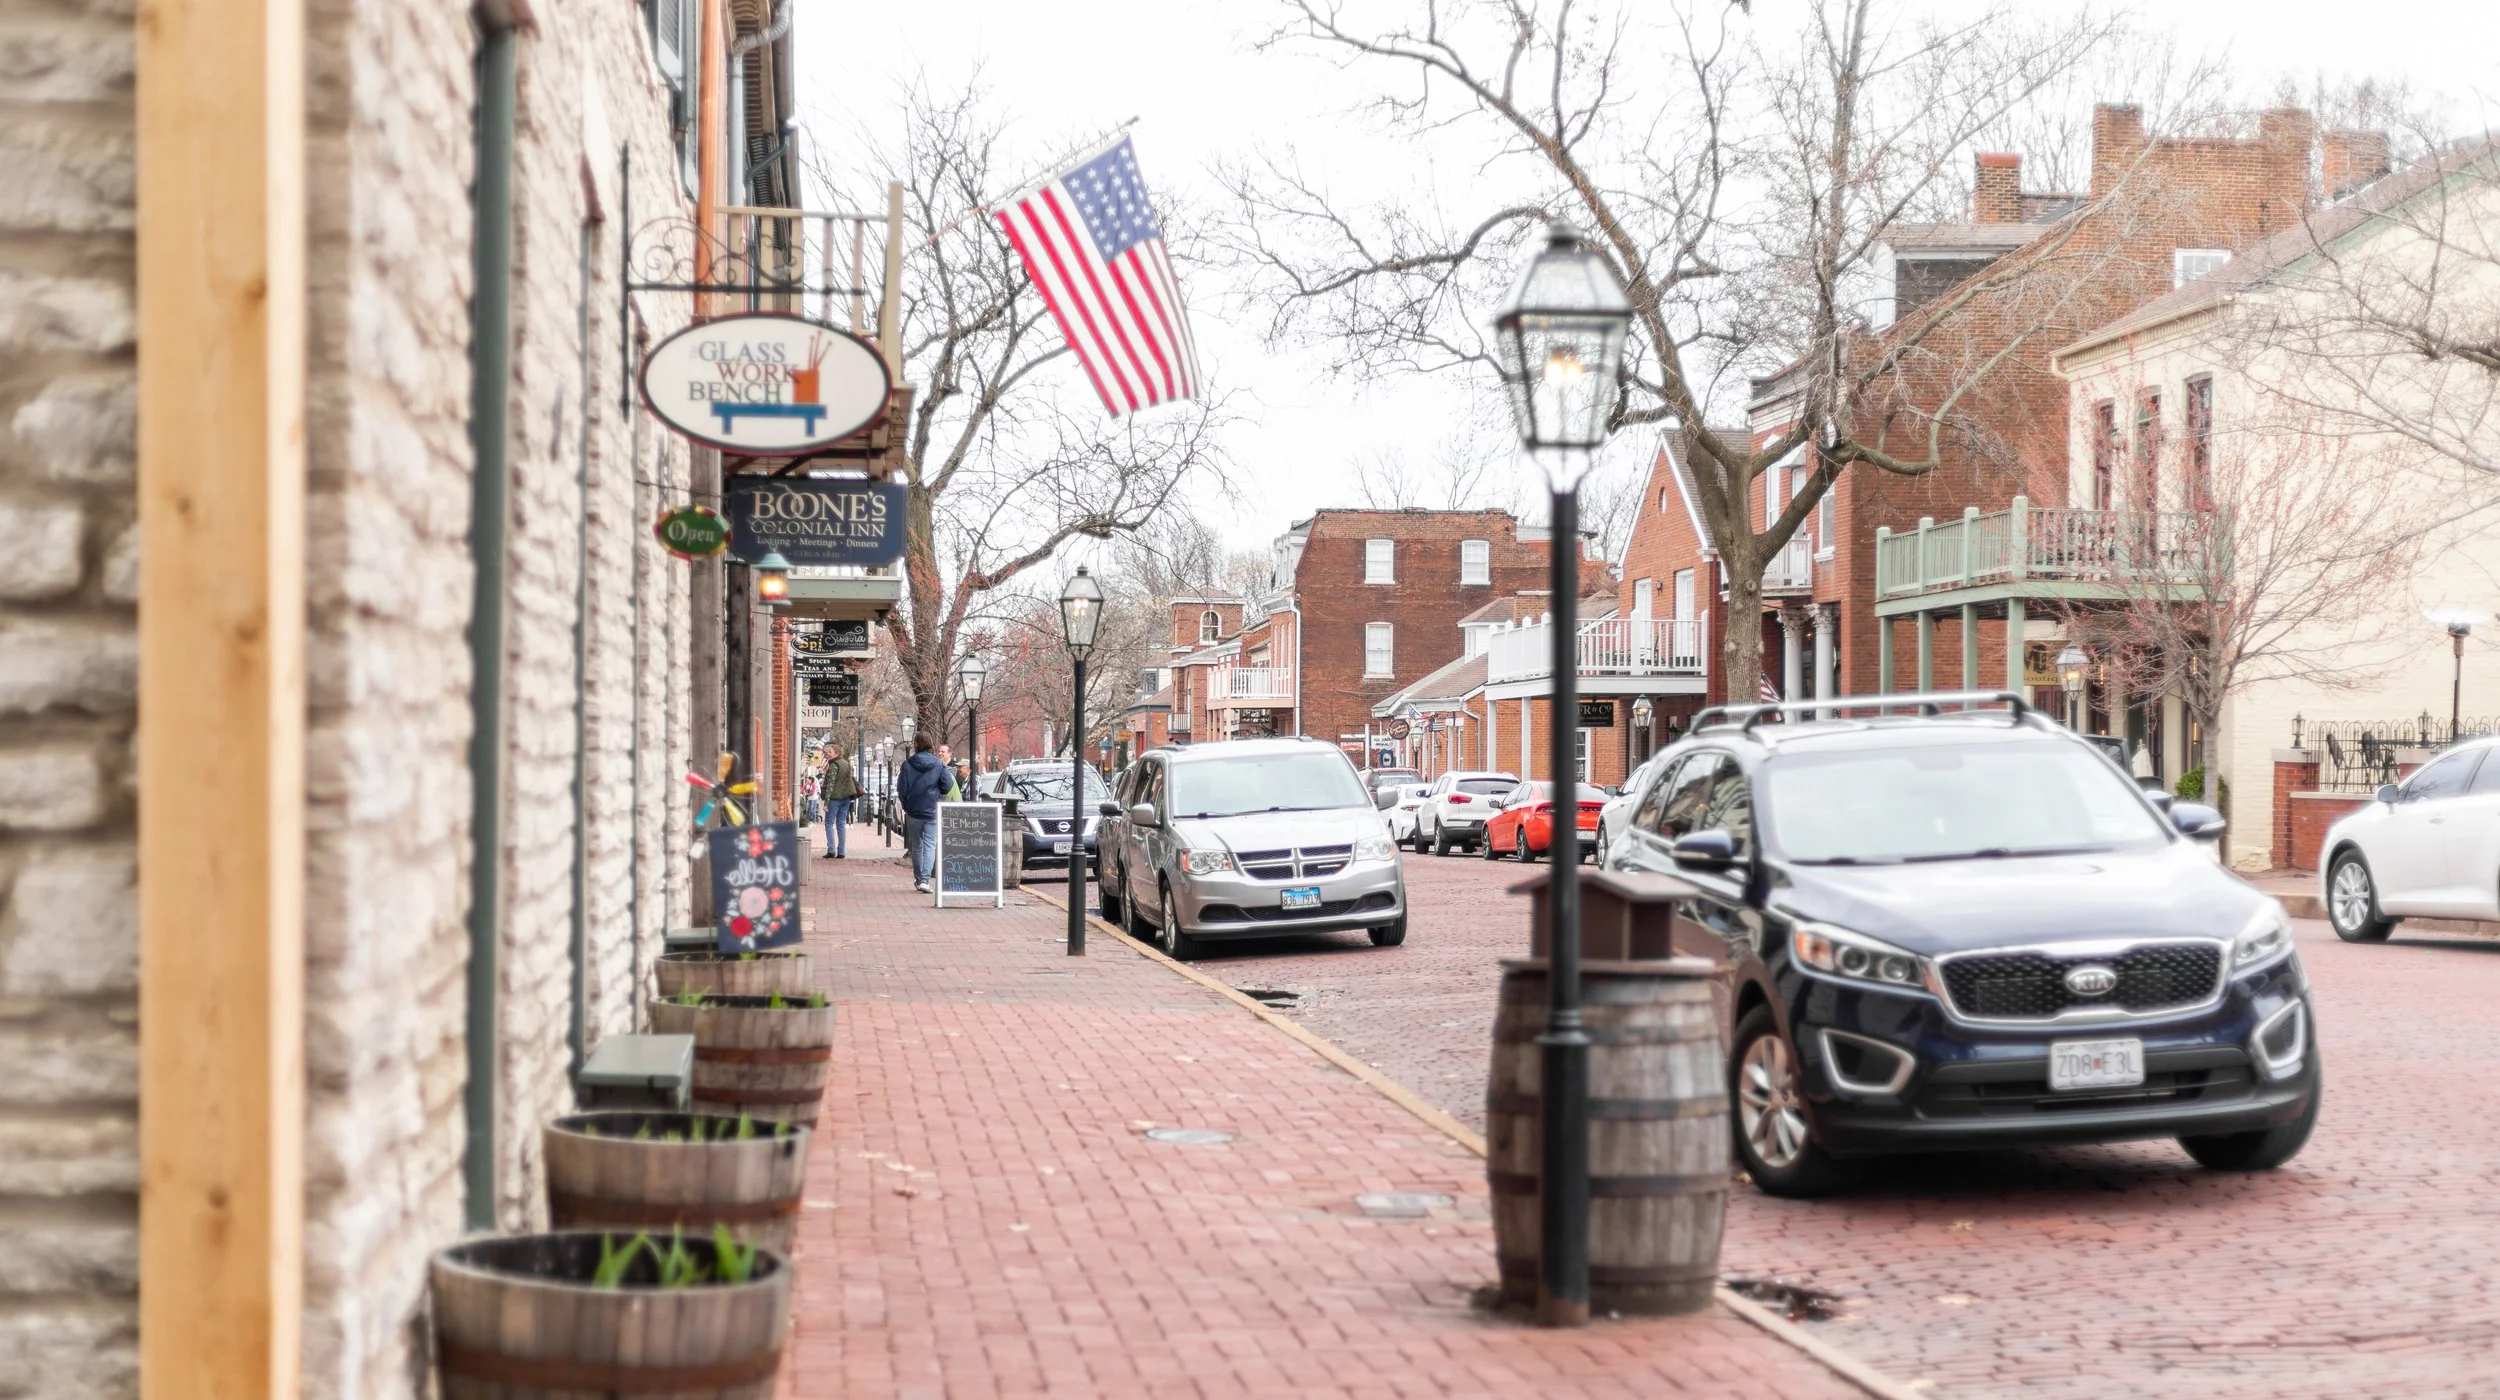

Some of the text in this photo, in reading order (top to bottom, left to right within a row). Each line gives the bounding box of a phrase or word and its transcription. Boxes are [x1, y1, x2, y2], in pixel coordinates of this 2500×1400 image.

[698, 341, 786, 363] GLASS
[715, 361, 800, 385] WORK
[688, 381, 782, 404] BENCH
[752, 490, 887, 522] BOONE'S
[667, 519, 715, 547] Open
[750, 520, 886, 538] COLONIAL INN
[799, 537, 837, 548] Meetings
[846, 538, 879, 548] Dinners
[799, 637, 823, 651] Spi
[2023, 676, 2059, 684] outiq
[801, 709, 831, 718] SHOP
[2075, 975, 2110, 990] KIA
